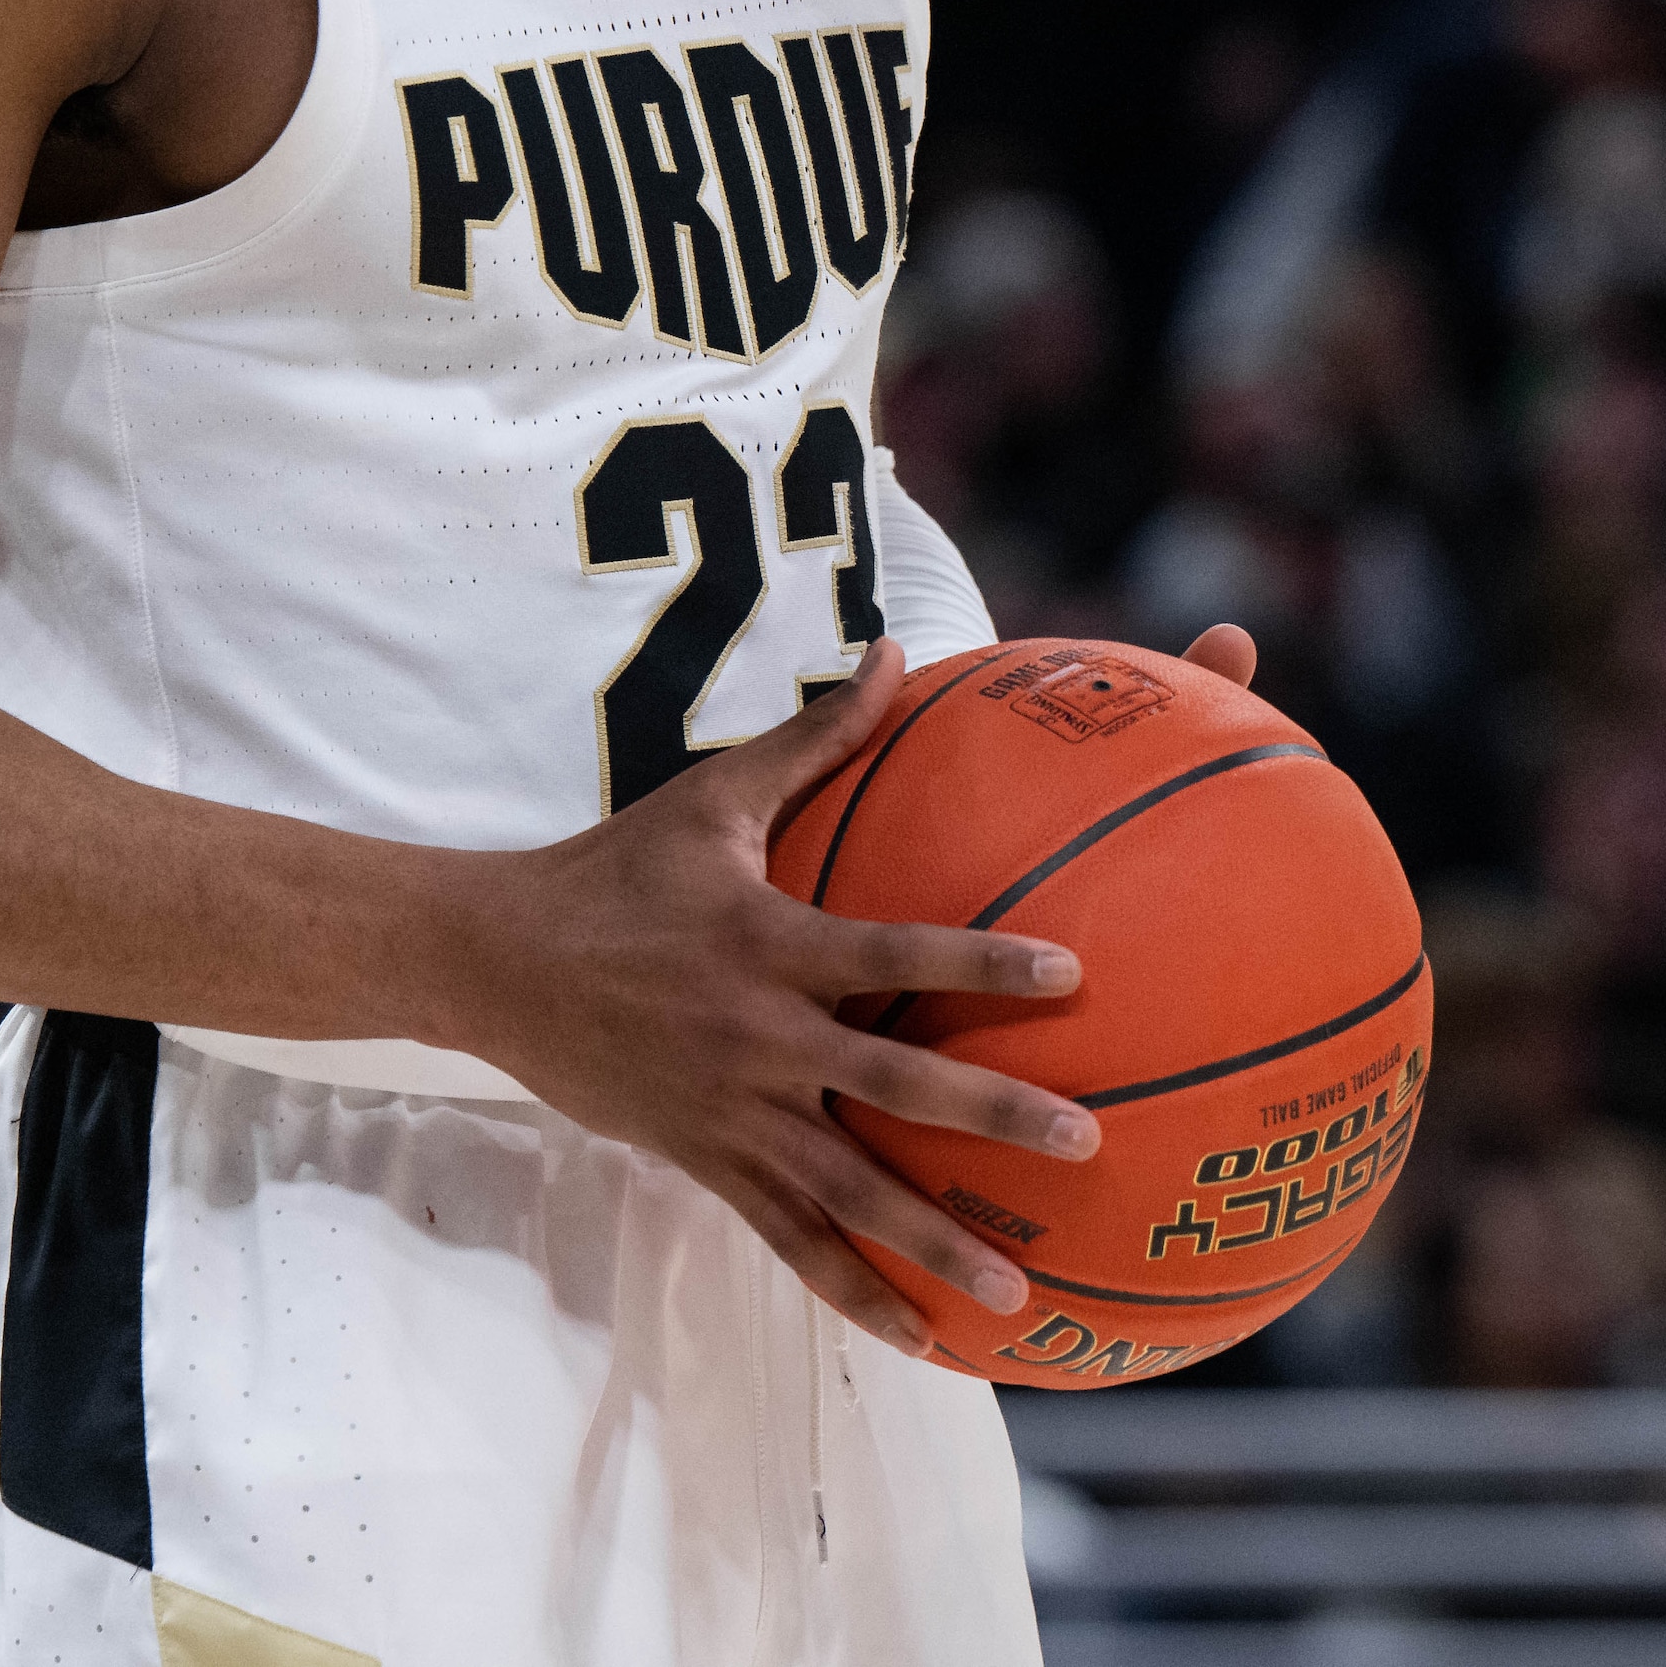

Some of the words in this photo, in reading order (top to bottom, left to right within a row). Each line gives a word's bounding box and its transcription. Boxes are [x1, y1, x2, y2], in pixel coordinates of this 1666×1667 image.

[573, 398, 886, 822] 23
[1306, 1081, 1347, 1115] GAME
[1350, 1042, 1401, 1094] OFFICIAL
[1193, 1088, 1389, 1188] 1000
[1259, 1098, 1300, 1129] BALL
[1146, 1081, 1426, 1262] EGACY
